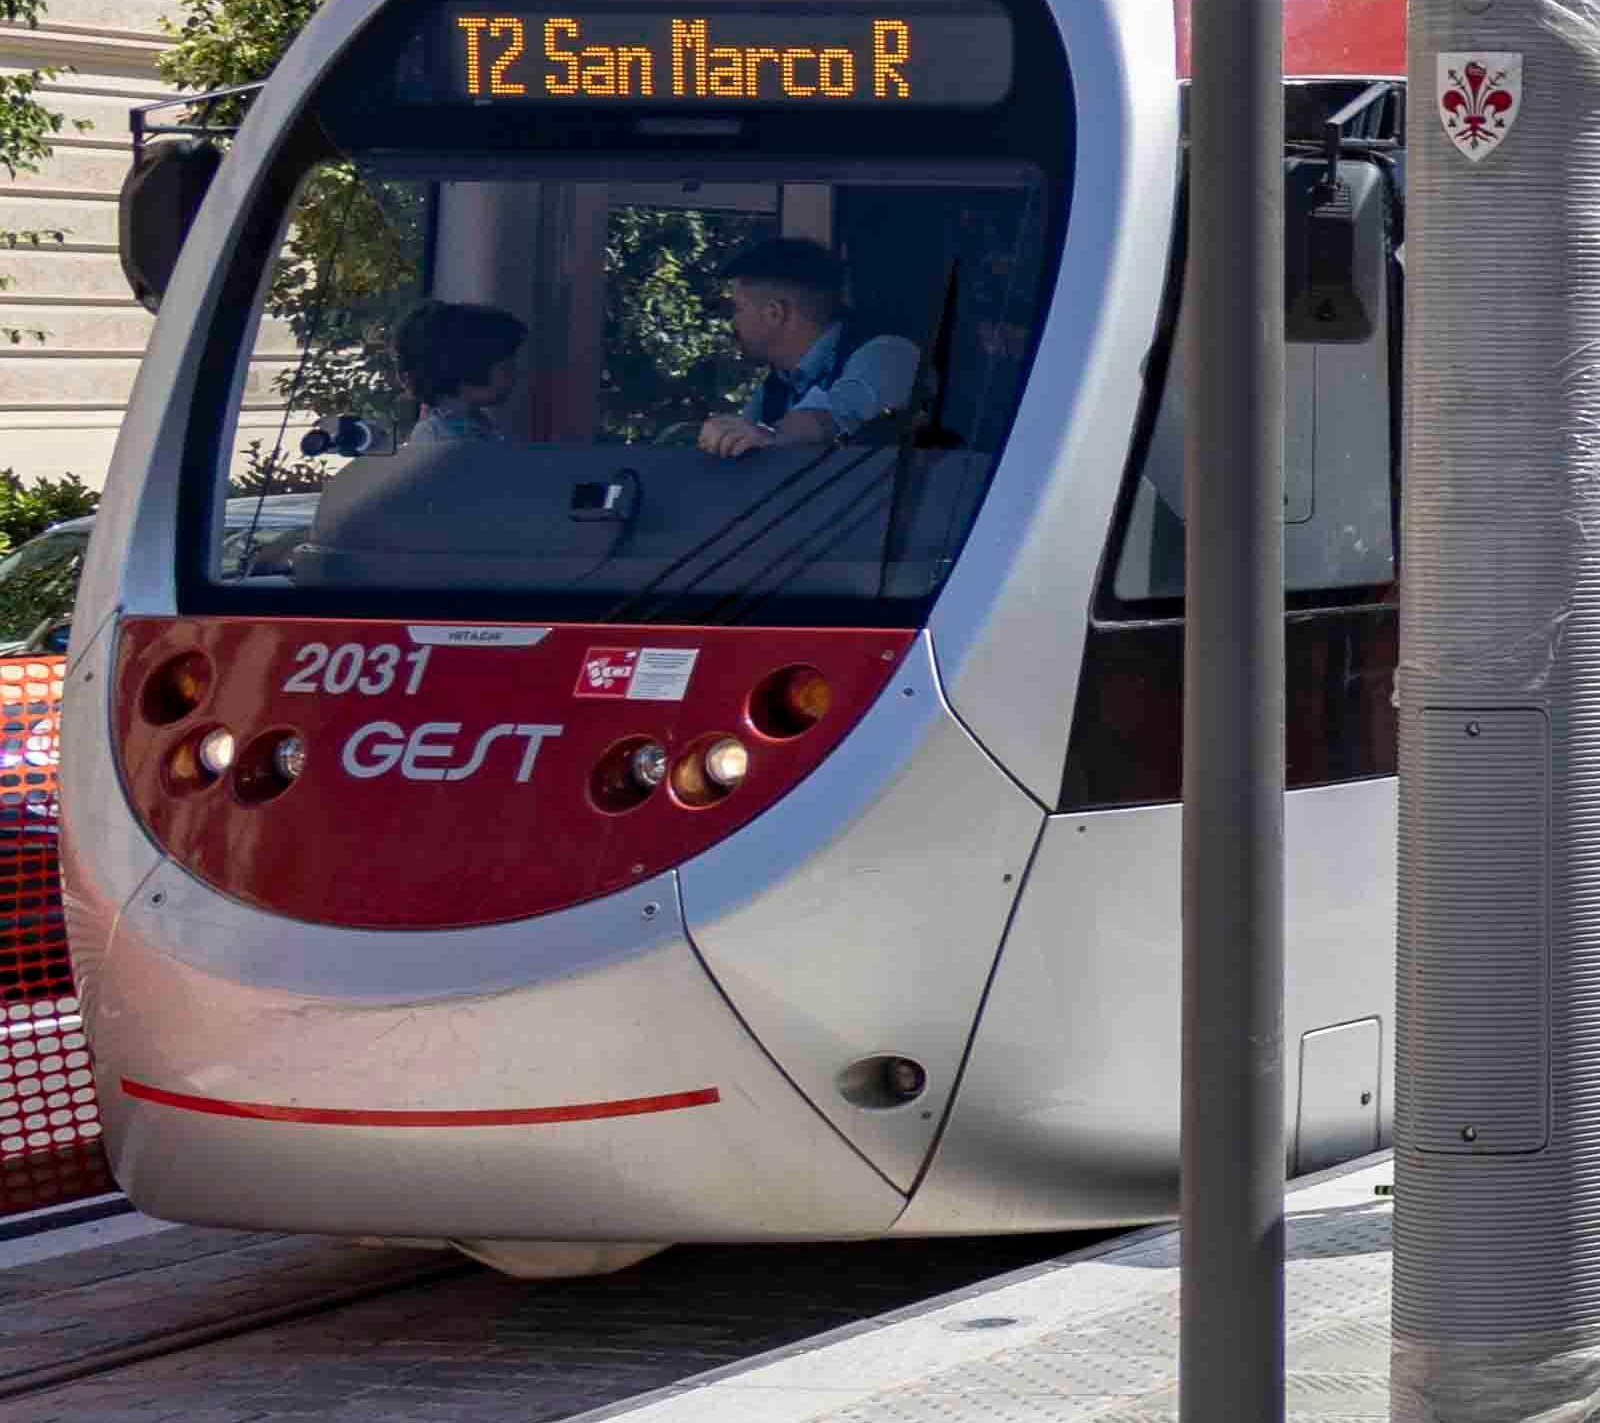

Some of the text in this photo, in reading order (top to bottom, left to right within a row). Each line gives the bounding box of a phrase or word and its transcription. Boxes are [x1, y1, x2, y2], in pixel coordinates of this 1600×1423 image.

[458, 17, 910, 98] T2 San Marco R
[282, 642, 433, 696] 2031
[341, 721, 565, 784] GEST
